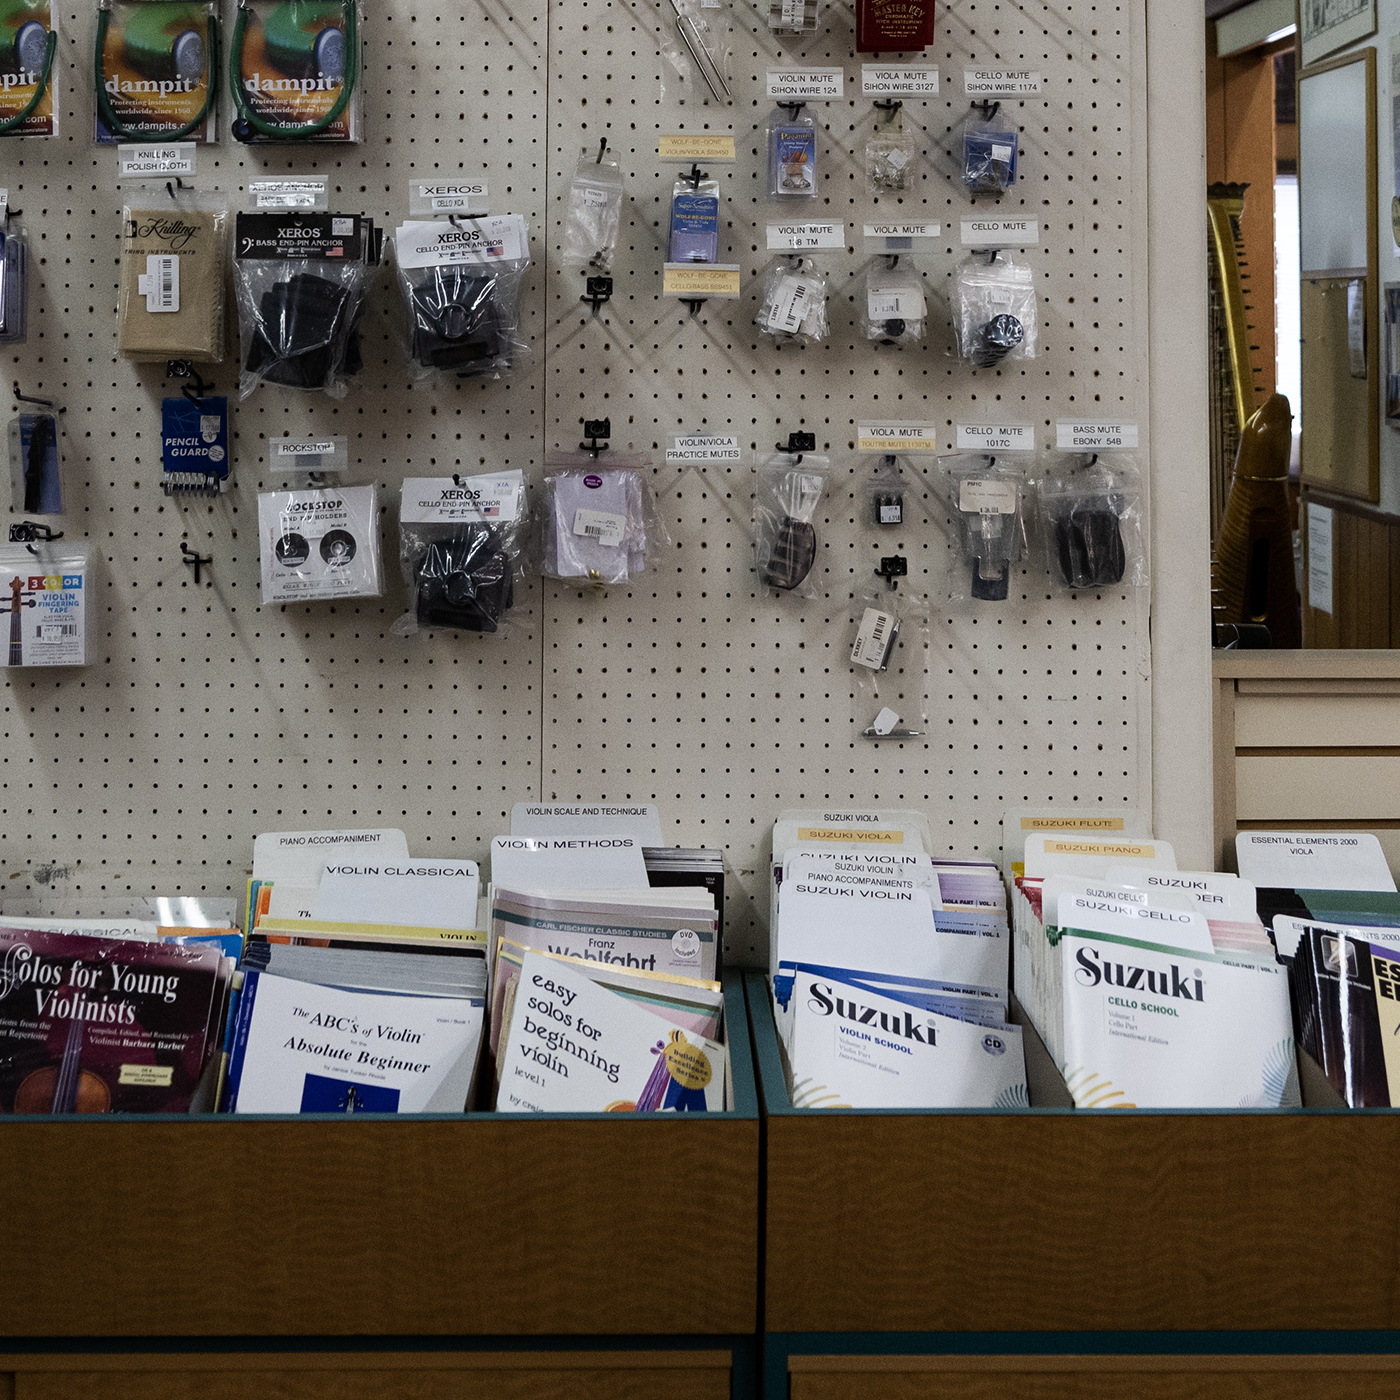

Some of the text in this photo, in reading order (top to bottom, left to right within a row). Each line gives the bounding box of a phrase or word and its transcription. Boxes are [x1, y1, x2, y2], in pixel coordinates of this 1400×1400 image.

[105, 74, 193, 97] dampit
[779, 75, 833, 84] VIOLIN MUTE
[425, 186, 483, 195] XEROS
[137, 219, 198, 248] Knilling
[278, 229, 319, 238] XEROS
[1074, 425, 1121, 434] BASS MUTE
[165, 437, 199, 447] PENCIL
[282, 445, 329, 453] ROCKSTOP
[1073, 437, 1122, 447] EBONY 54B
[171, 448, 208, 457] GUARD
[1251, 837, 1293, 845] ESSENTIAL
[326, 866, 474, 877] VIOLIN CLASSICAL
[796, 883, 912, 900] SUZUKI VIOLIN
[69, 958, 101, 990] for
[107, 963, 179, 1003] Young
[1075, 946, 1204, 1003] Suzuki
[532, 973, 577, 1005] easy
[34, 988, 136, 1025] Violinists
[807, 982, 939, 1046] Suzuki
[1108, 996, 1179, 1017] CELLO SCHOOL
[527, 994, 602, 1041] solos for
[523, 1016, 620, 1083] beginning
[519, 1044, 569, 1079] violin
